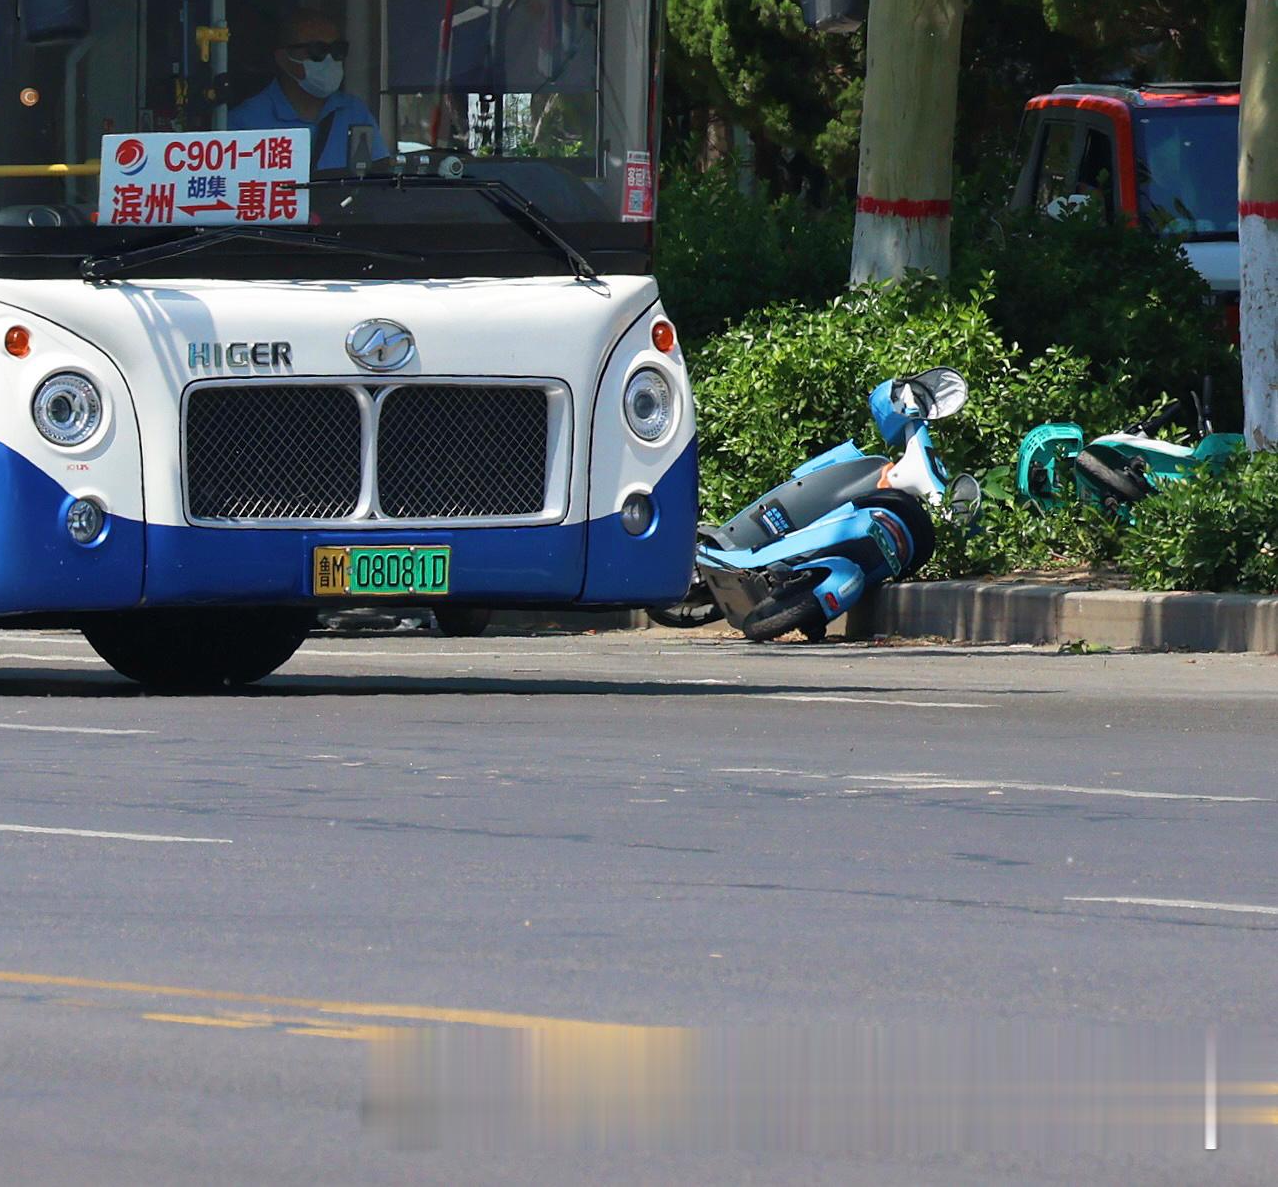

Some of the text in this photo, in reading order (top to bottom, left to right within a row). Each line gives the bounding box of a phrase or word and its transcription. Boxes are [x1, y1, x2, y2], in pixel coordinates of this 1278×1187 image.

[163, 136, 293, 172] C901-1路
[111, 180, 298, 224] 滨州 惠民
[187, 176, 227, 198] 胡集
[188, 342, 292, 368] HIGER
